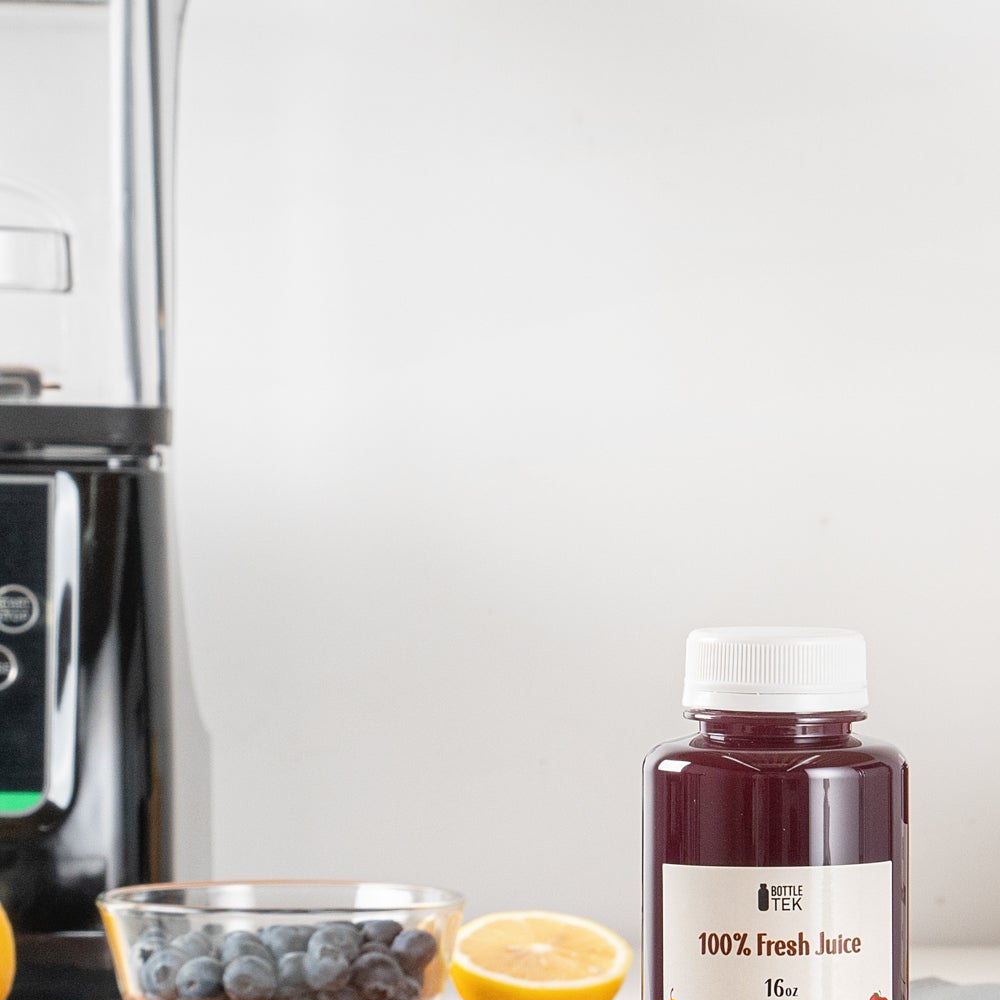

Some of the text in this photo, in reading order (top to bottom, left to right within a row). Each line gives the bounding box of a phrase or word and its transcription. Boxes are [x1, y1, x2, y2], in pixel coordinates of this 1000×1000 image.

[771, 885, 803, 897] BOTTLE
[771, 897, 803, 911] TEK
[698, 931, 862, 957] 100% Fresh Juice
[764, 978, 799, 998] 16oz
